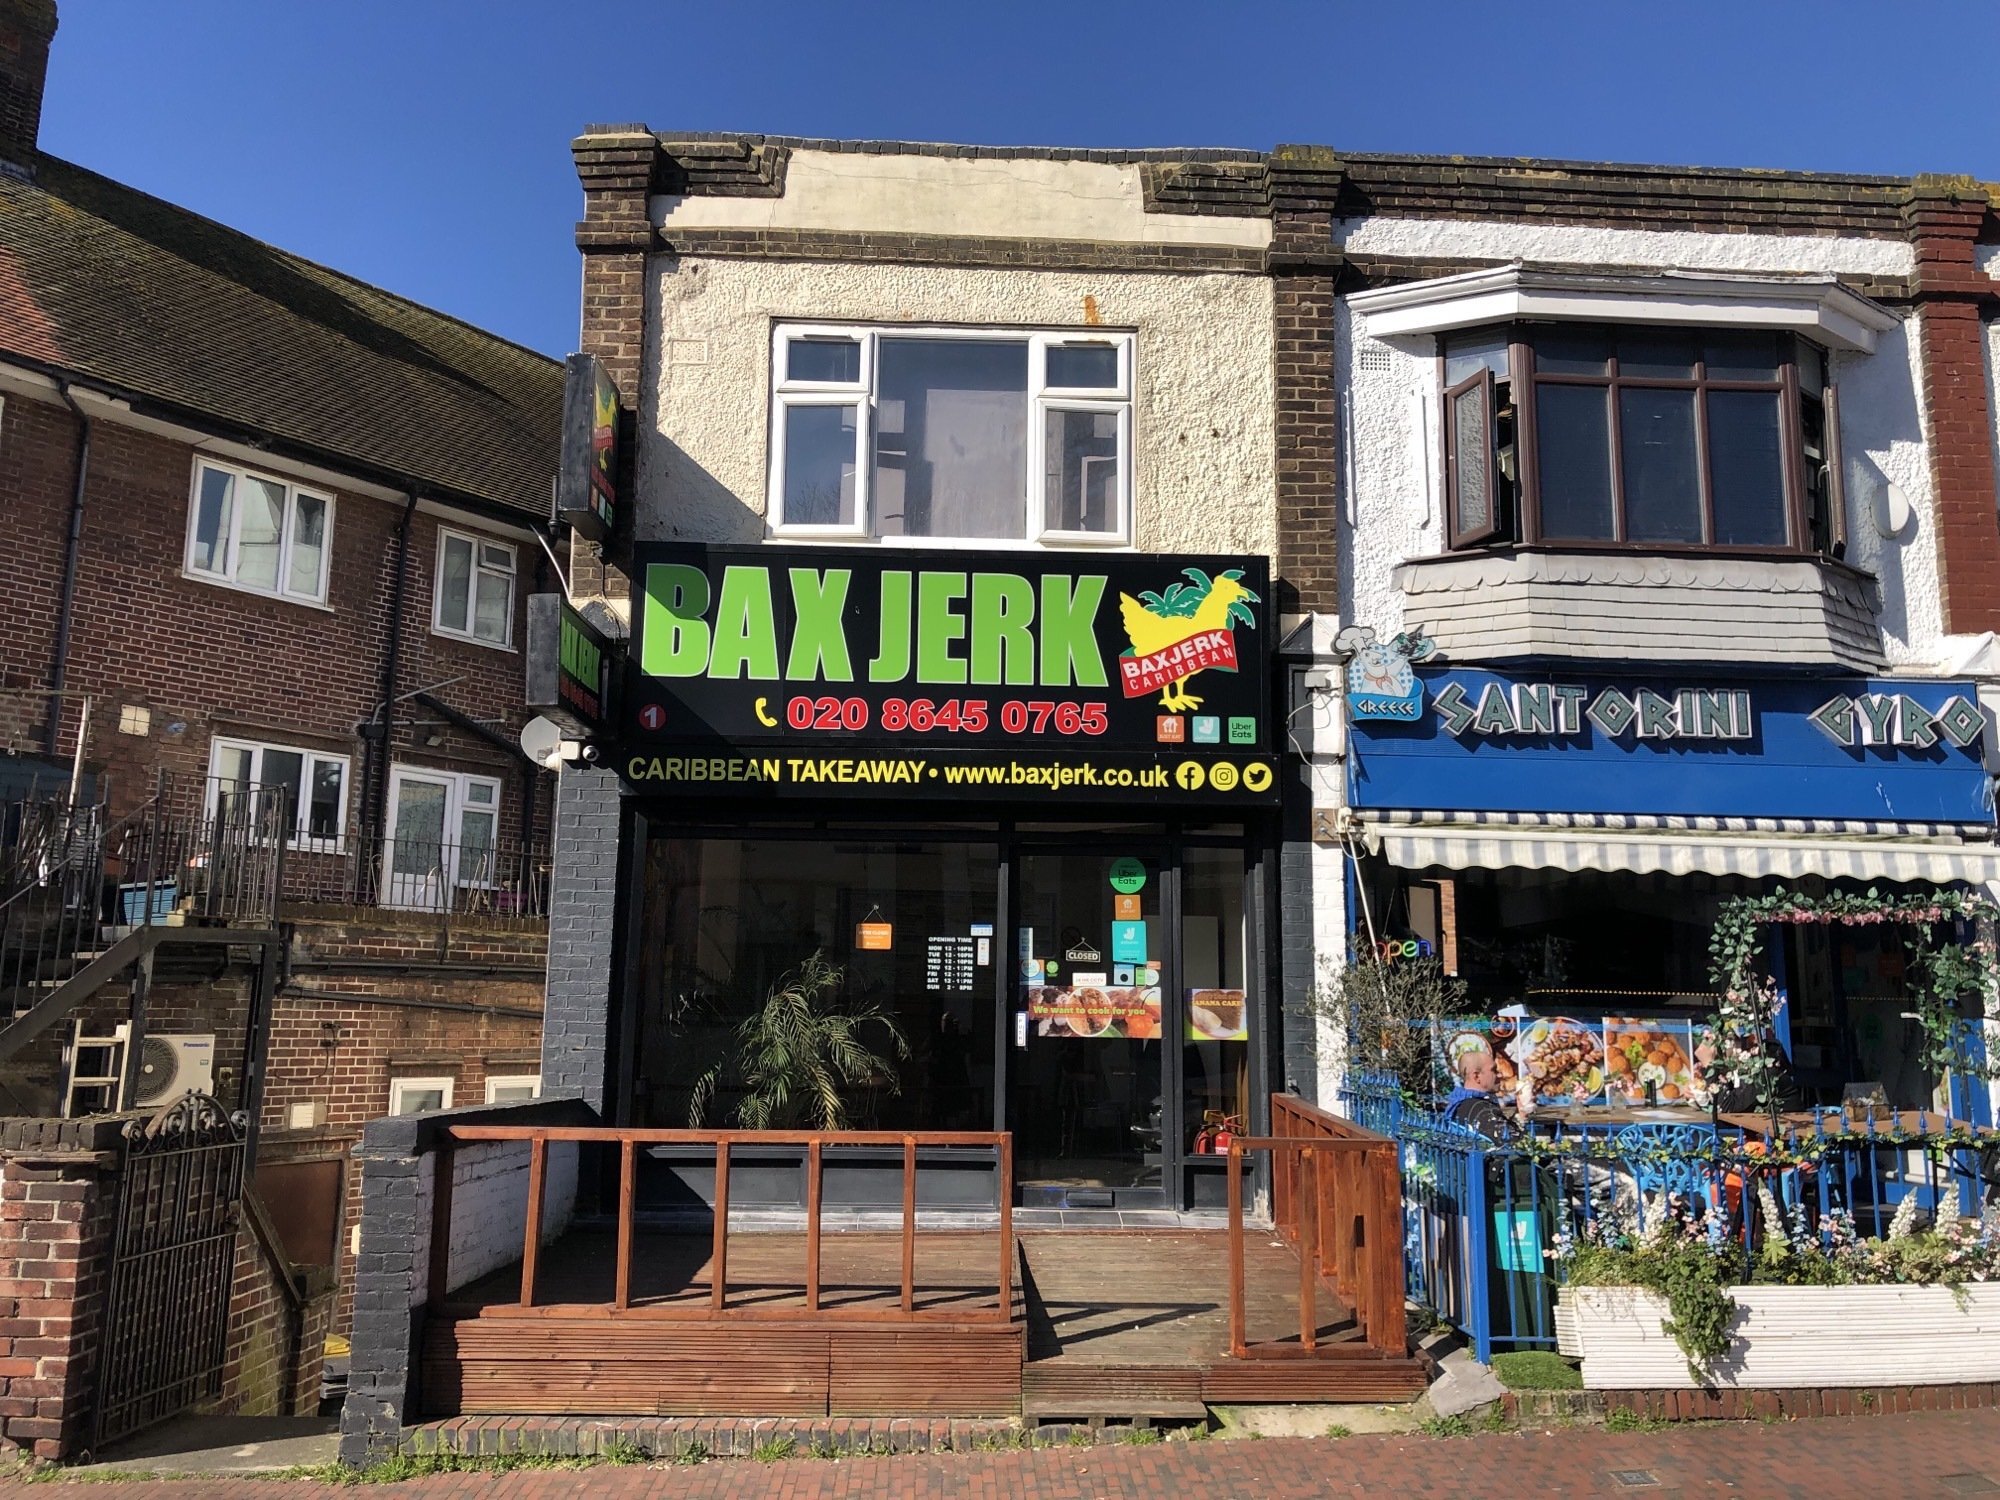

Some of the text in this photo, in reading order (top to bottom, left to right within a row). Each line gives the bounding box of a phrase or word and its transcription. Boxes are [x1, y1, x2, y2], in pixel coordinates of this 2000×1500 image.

[642, 563, 1109, 688] BAX JERK
[1122, 631, 1228, 678] BAXJERK
[1130, 648, 1234, 690] CARIBBEAN
[644, 706, 658, 728] 1
[787, 696, 1108, 736] 020 8645 0765
[1357, 699, 1415, 716] GREECE
[1432, 681, 1987, 748] SANTORINI GYRO
[1231, 722, 1252, 730] Uber
[1231, 730, 1252, 738] Eats
[628, 757, 1169, 790] CARIBBEAN TAKEAWAY www.baxjerk.co.uk
[1068, 952, 1098, 960] CLOSED
[1374, 940, 1432, 965] open
